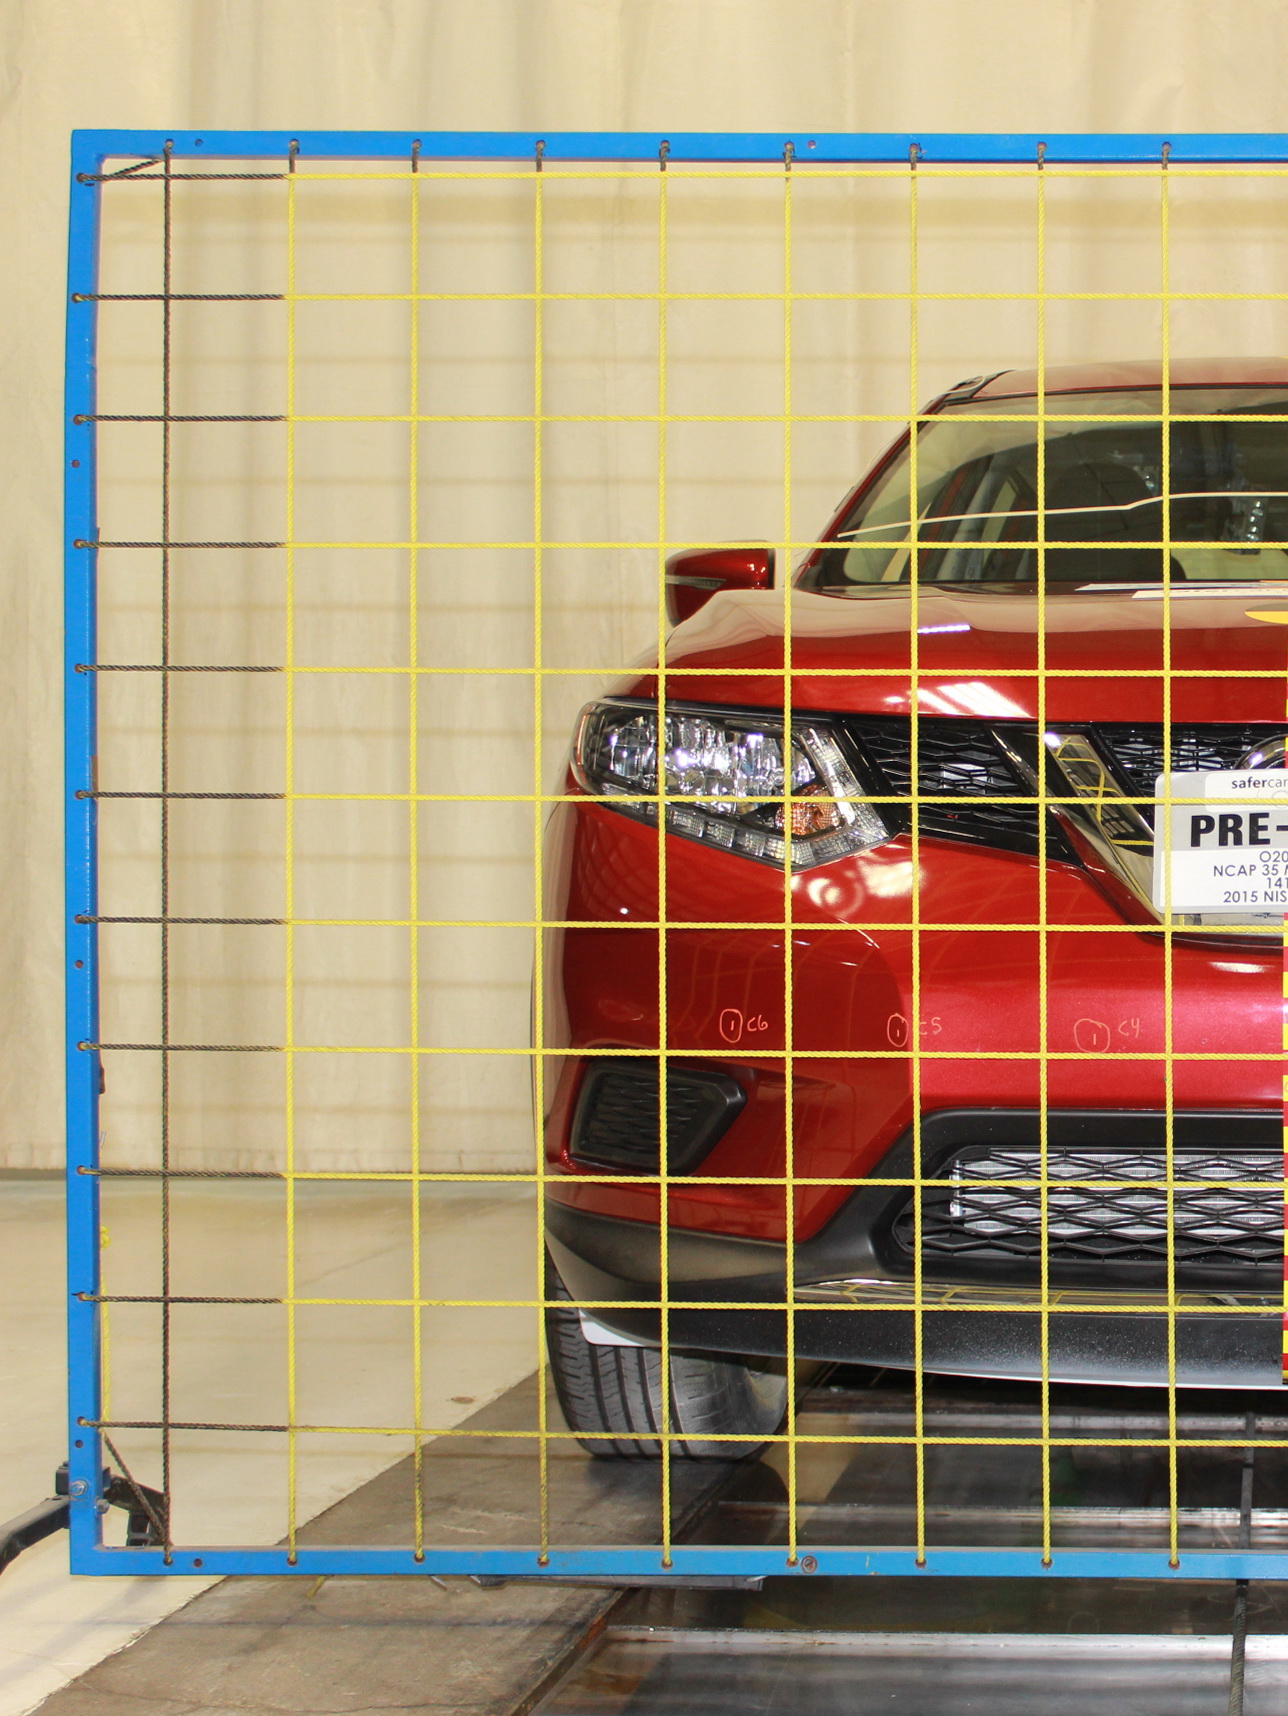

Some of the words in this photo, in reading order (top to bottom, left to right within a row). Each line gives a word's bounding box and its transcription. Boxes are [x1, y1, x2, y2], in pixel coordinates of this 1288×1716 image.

[1213, 864, 1257, 877] NCAP
[1261, 863, 1279, 876] 35
[1223, 890, 1258, 903] 2015
